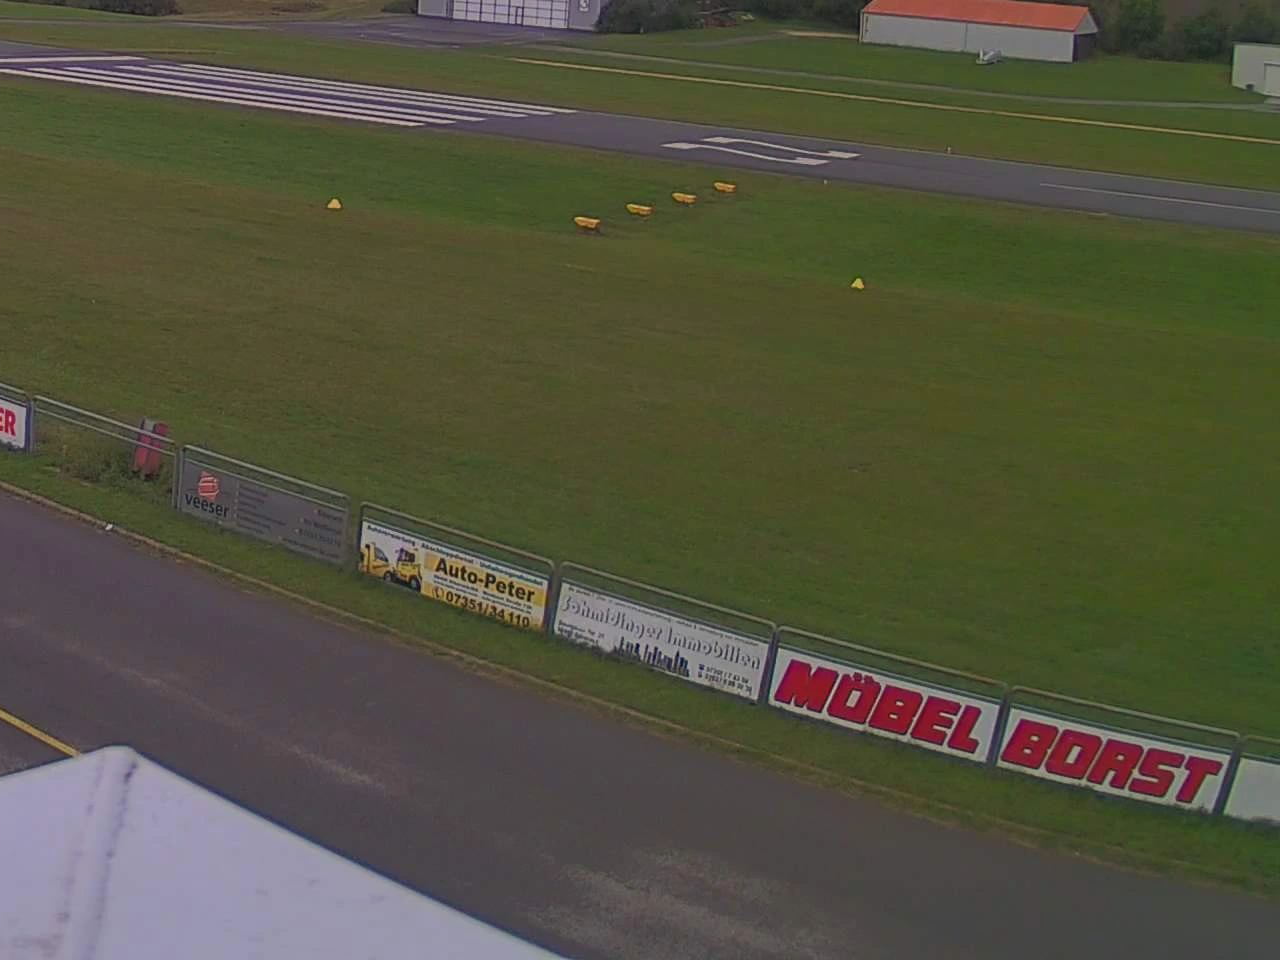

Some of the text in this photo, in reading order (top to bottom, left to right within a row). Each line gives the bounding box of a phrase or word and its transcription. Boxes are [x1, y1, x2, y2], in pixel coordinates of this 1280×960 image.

[185, 493, 230, 519] veeser
[436, 558, 535, 603] Auto-Peter
[668, 626, 761, 671] Immobilien
[773, 658, 982, 754] MÖBEL
[1000, 718, 1223, 804] BORST
